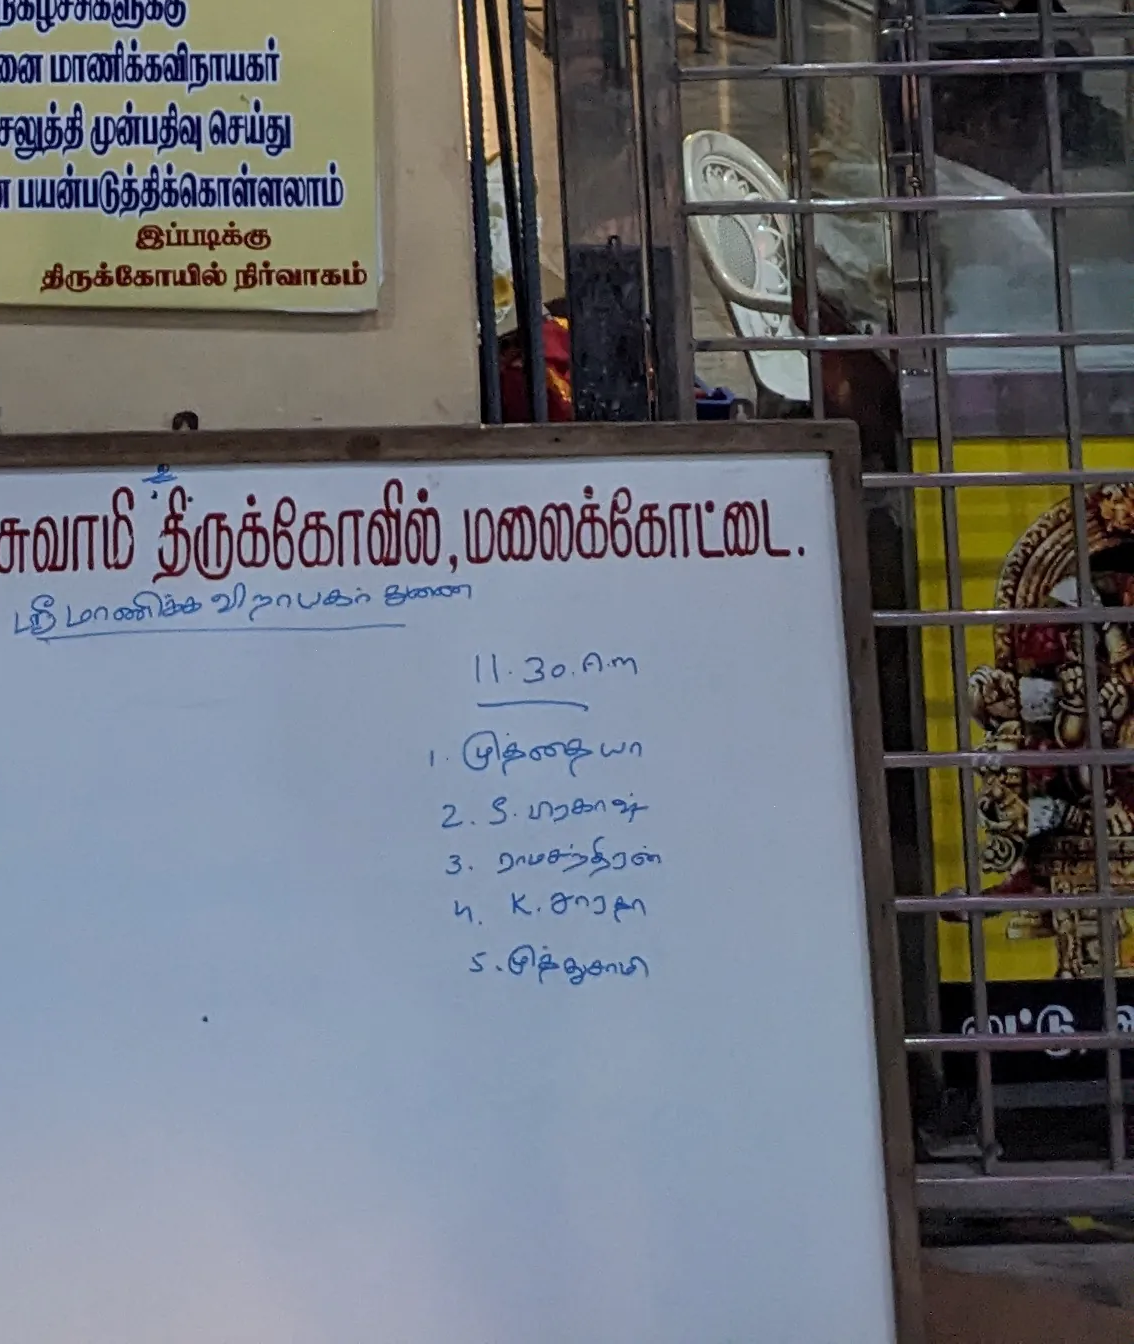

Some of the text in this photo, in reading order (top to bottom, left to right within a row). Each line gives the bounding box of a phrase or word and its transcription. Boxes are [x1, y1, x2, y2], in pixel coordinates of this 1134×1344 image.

[50, 37, 279, 92] மாணிக்கவிநாயகர்
[90, 103, 201, 154] முன்பதிவு
[209, 103, 292, 157] செய்து
[17, 162, 344, 219] பயன்படுத்திக்கொள்ளலாம்
[136, 221, 271, 251] இப்படிக்கு
[40, 261, 368, 292] திருக்கோயில் நிர்வாகம்
[66, 590, 201, 628] மாணிக்க
[441, 804, 475, 828] 2.
[445, 854, 474, 876] 3.
